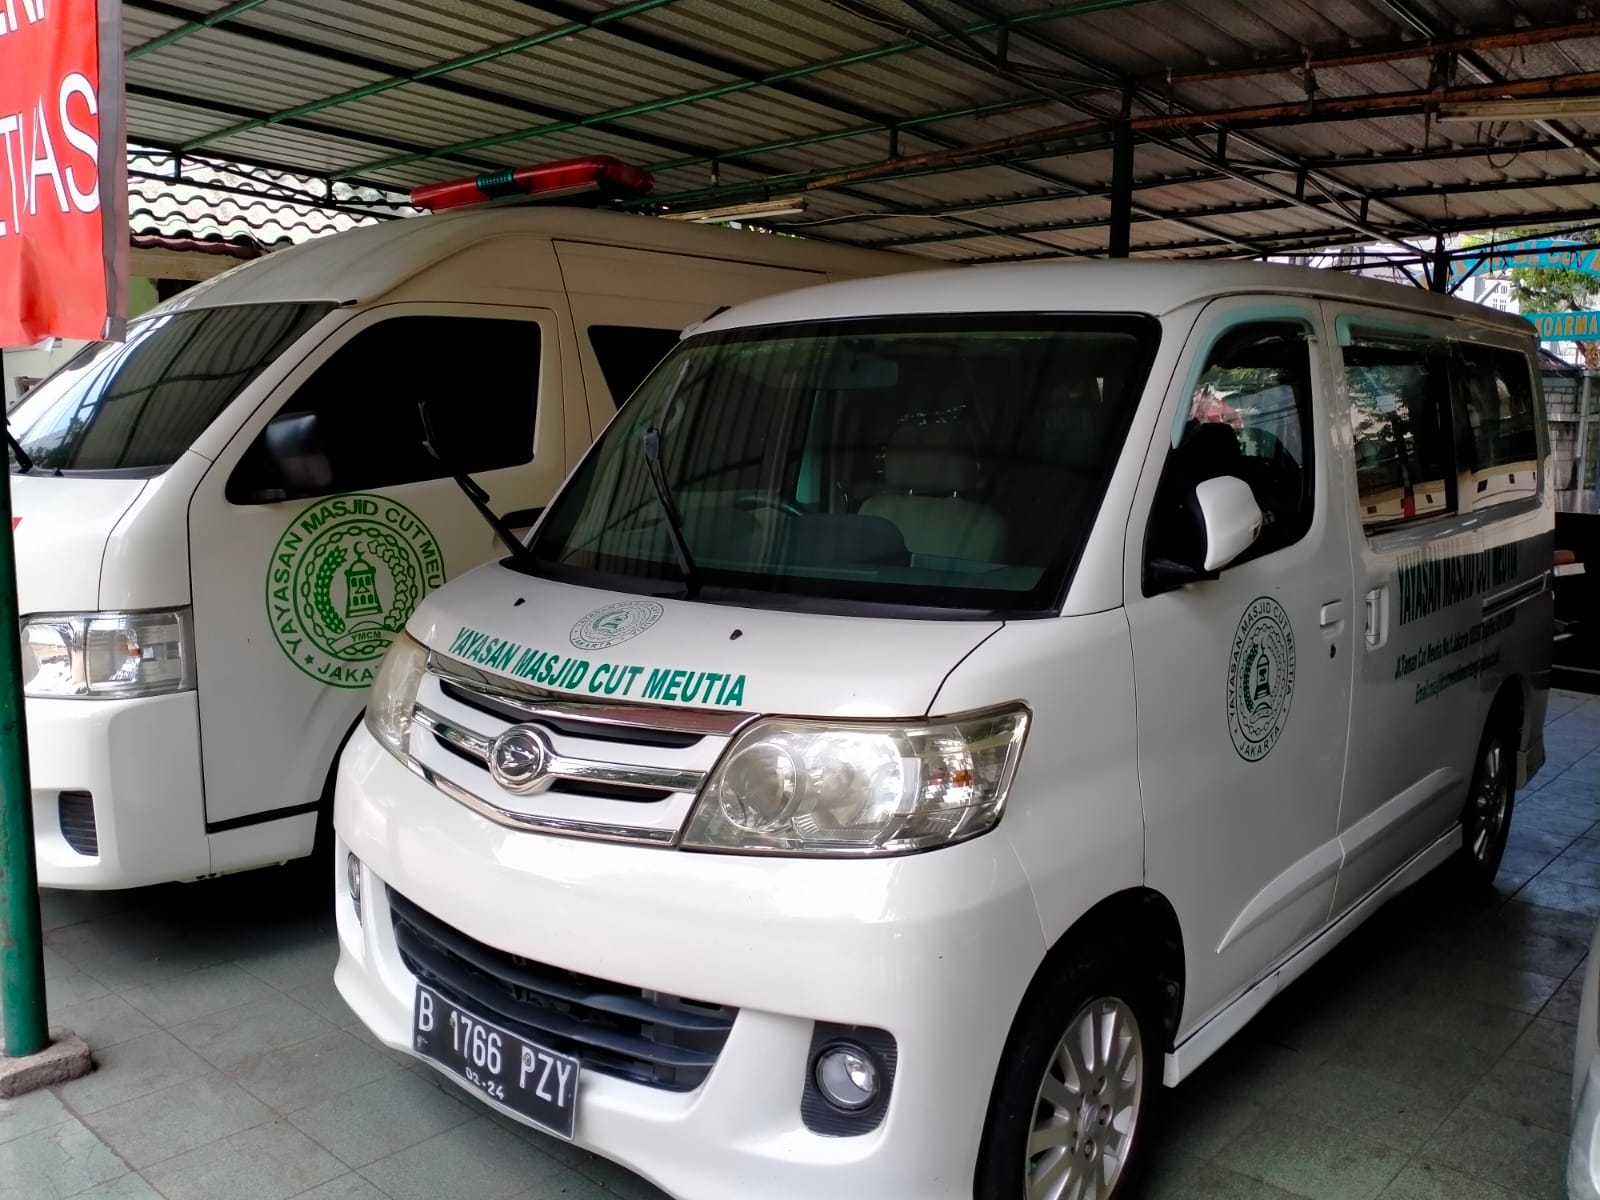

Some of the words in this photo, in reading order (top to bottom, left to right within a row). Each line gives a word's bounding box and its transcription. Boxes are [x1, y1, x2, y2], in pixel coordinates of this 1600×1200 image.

[274, 532, 303, 655] YAYASAN
[301, 499, 379, 535] MASJID
[385, 507, 427, 541] CUT
[419, 539, 442, 590] MEU
[318, 662, 378, 682] JAKA
[351, 630, 382, 642] YMCM
[449, 626, 518, 671] YAYASAN
[510, 647, 590, 690] MASJID
[588, 663, 646, 696] CUT
[641, 668, 747, 707] MEUTIA
[1228, 636, 1243, 722] YAYASAN
[1241, 602, 1271, 635] MASJID
[1273, 606, 1288, 631] CUT
[1239, 725, 1280, 757] JAKARTA
[418, 990, 434, 1032] B
[450, 1010, 503, 1075] 1766
[519, 1045, 572, 1107] PZY
